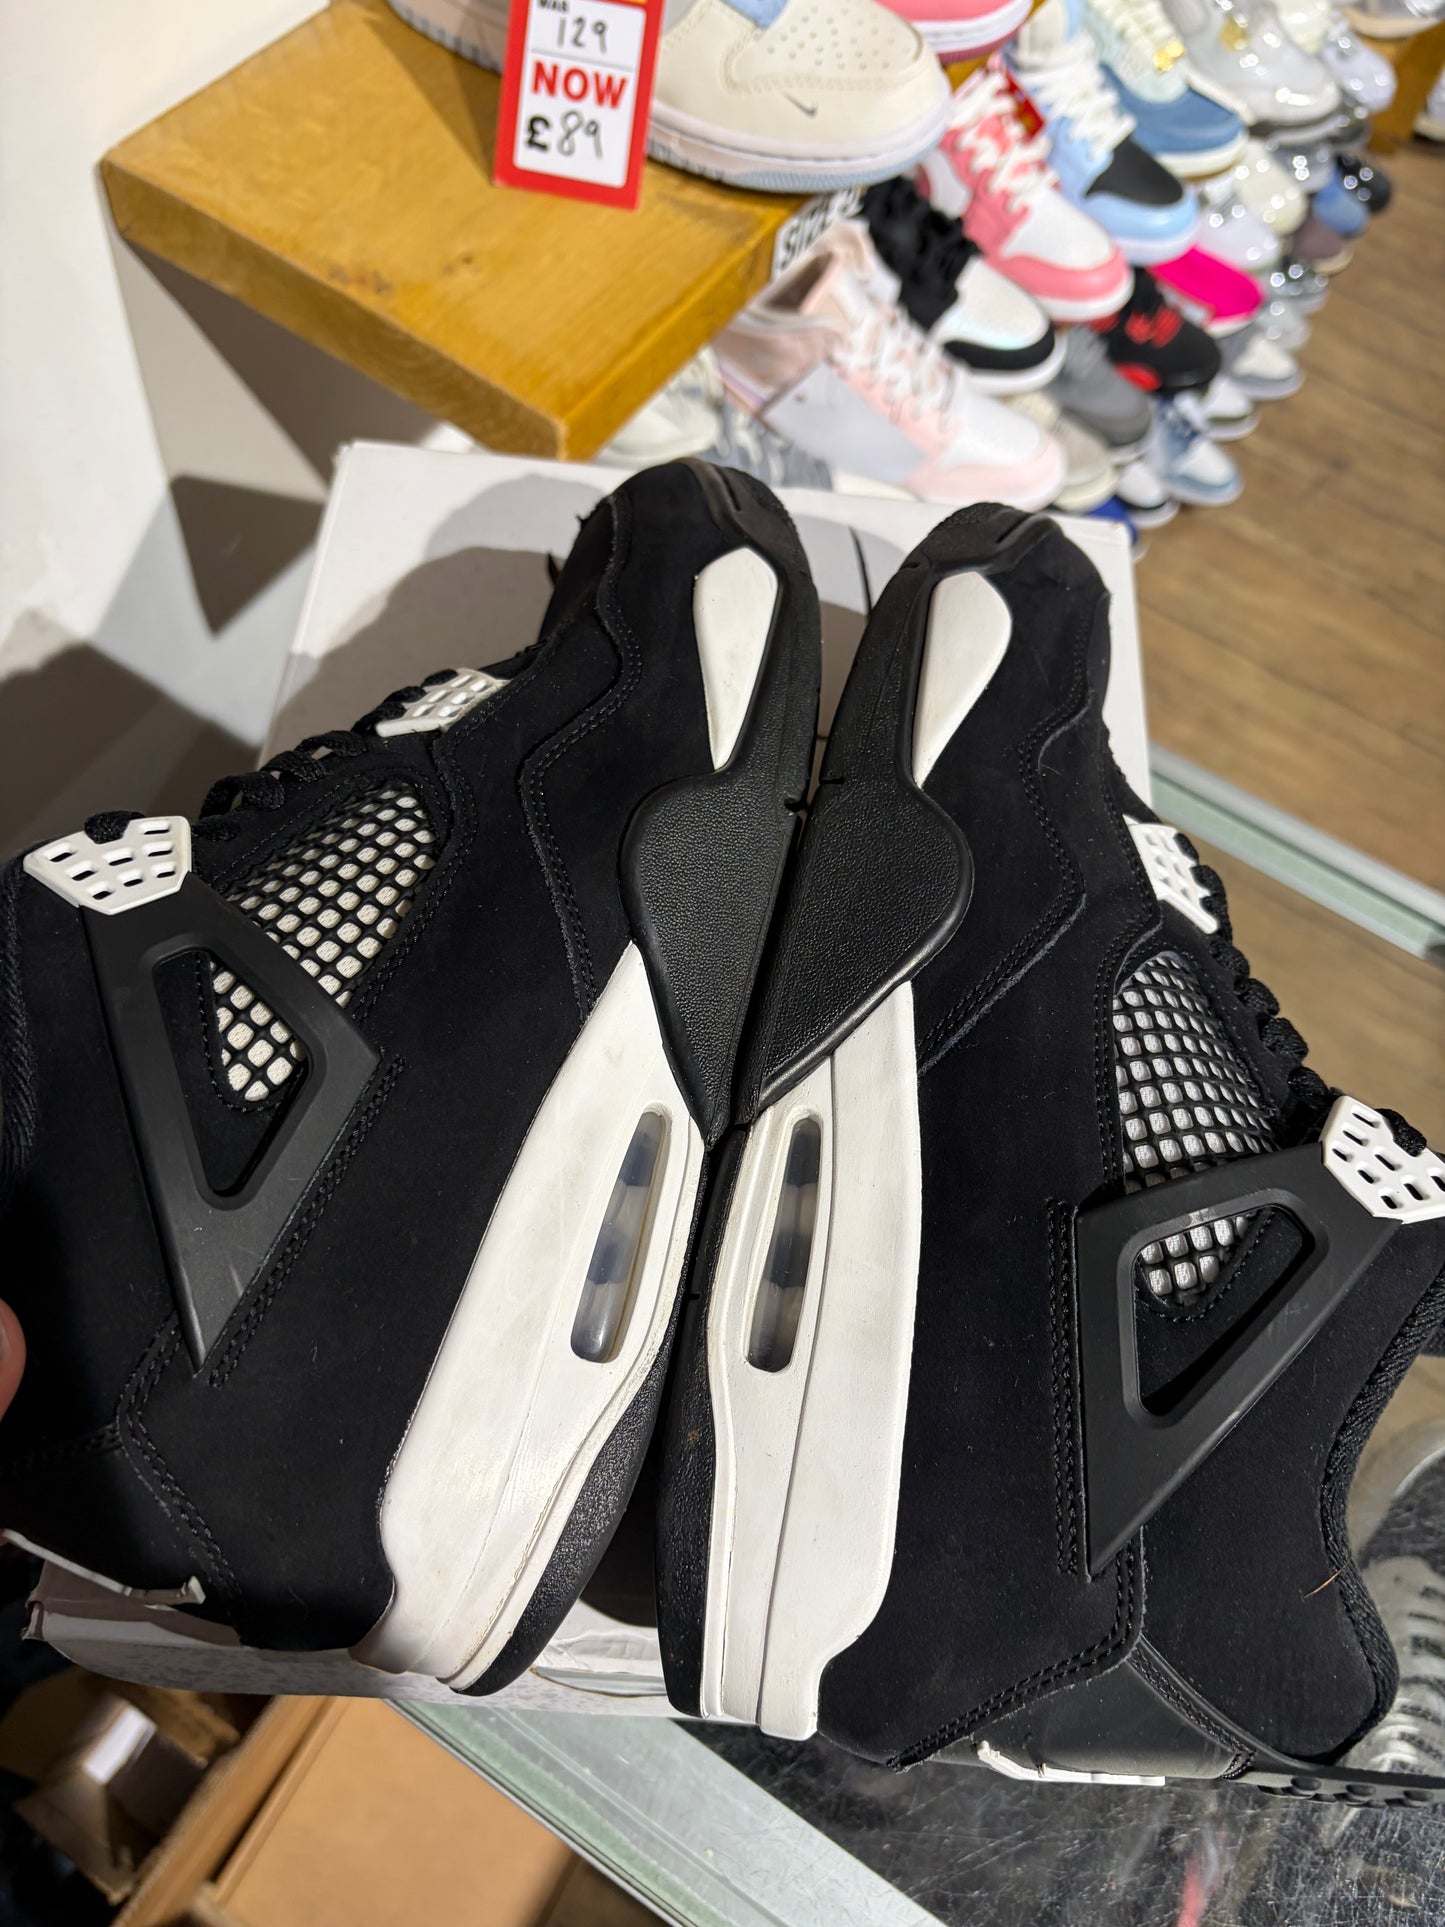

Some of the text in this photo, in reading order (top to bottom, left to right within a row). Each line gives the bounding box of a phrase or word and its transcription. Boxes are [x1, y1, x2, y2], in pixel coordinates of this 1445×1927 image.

[557, 16, 607, 53] 129
[532, 60, 627, 109] NOW
[527, 111, 603, 159] £89
